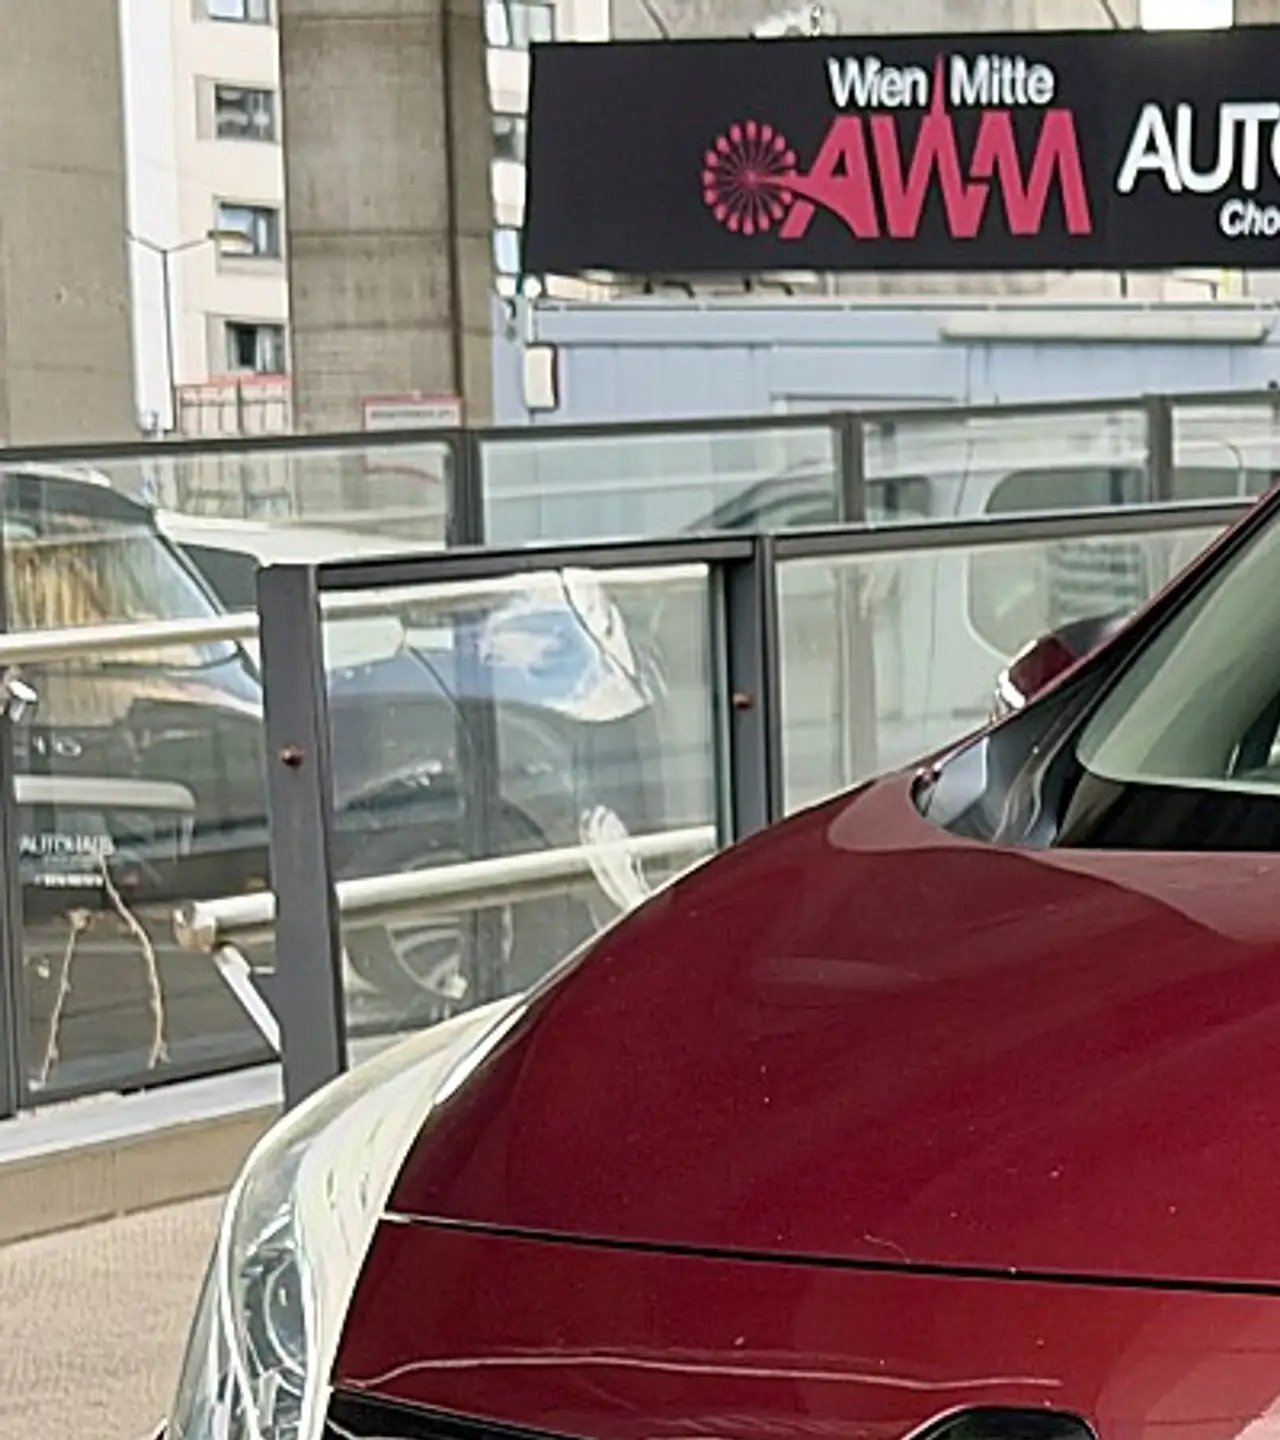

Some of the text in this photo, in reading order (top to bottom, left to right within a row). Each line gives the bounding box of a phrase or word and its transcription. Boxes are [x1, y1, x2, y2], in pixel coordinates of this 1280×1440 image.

[828, 54, 1055, 107] Wien Mitte
[778, 110, 1092, 238] AWM
